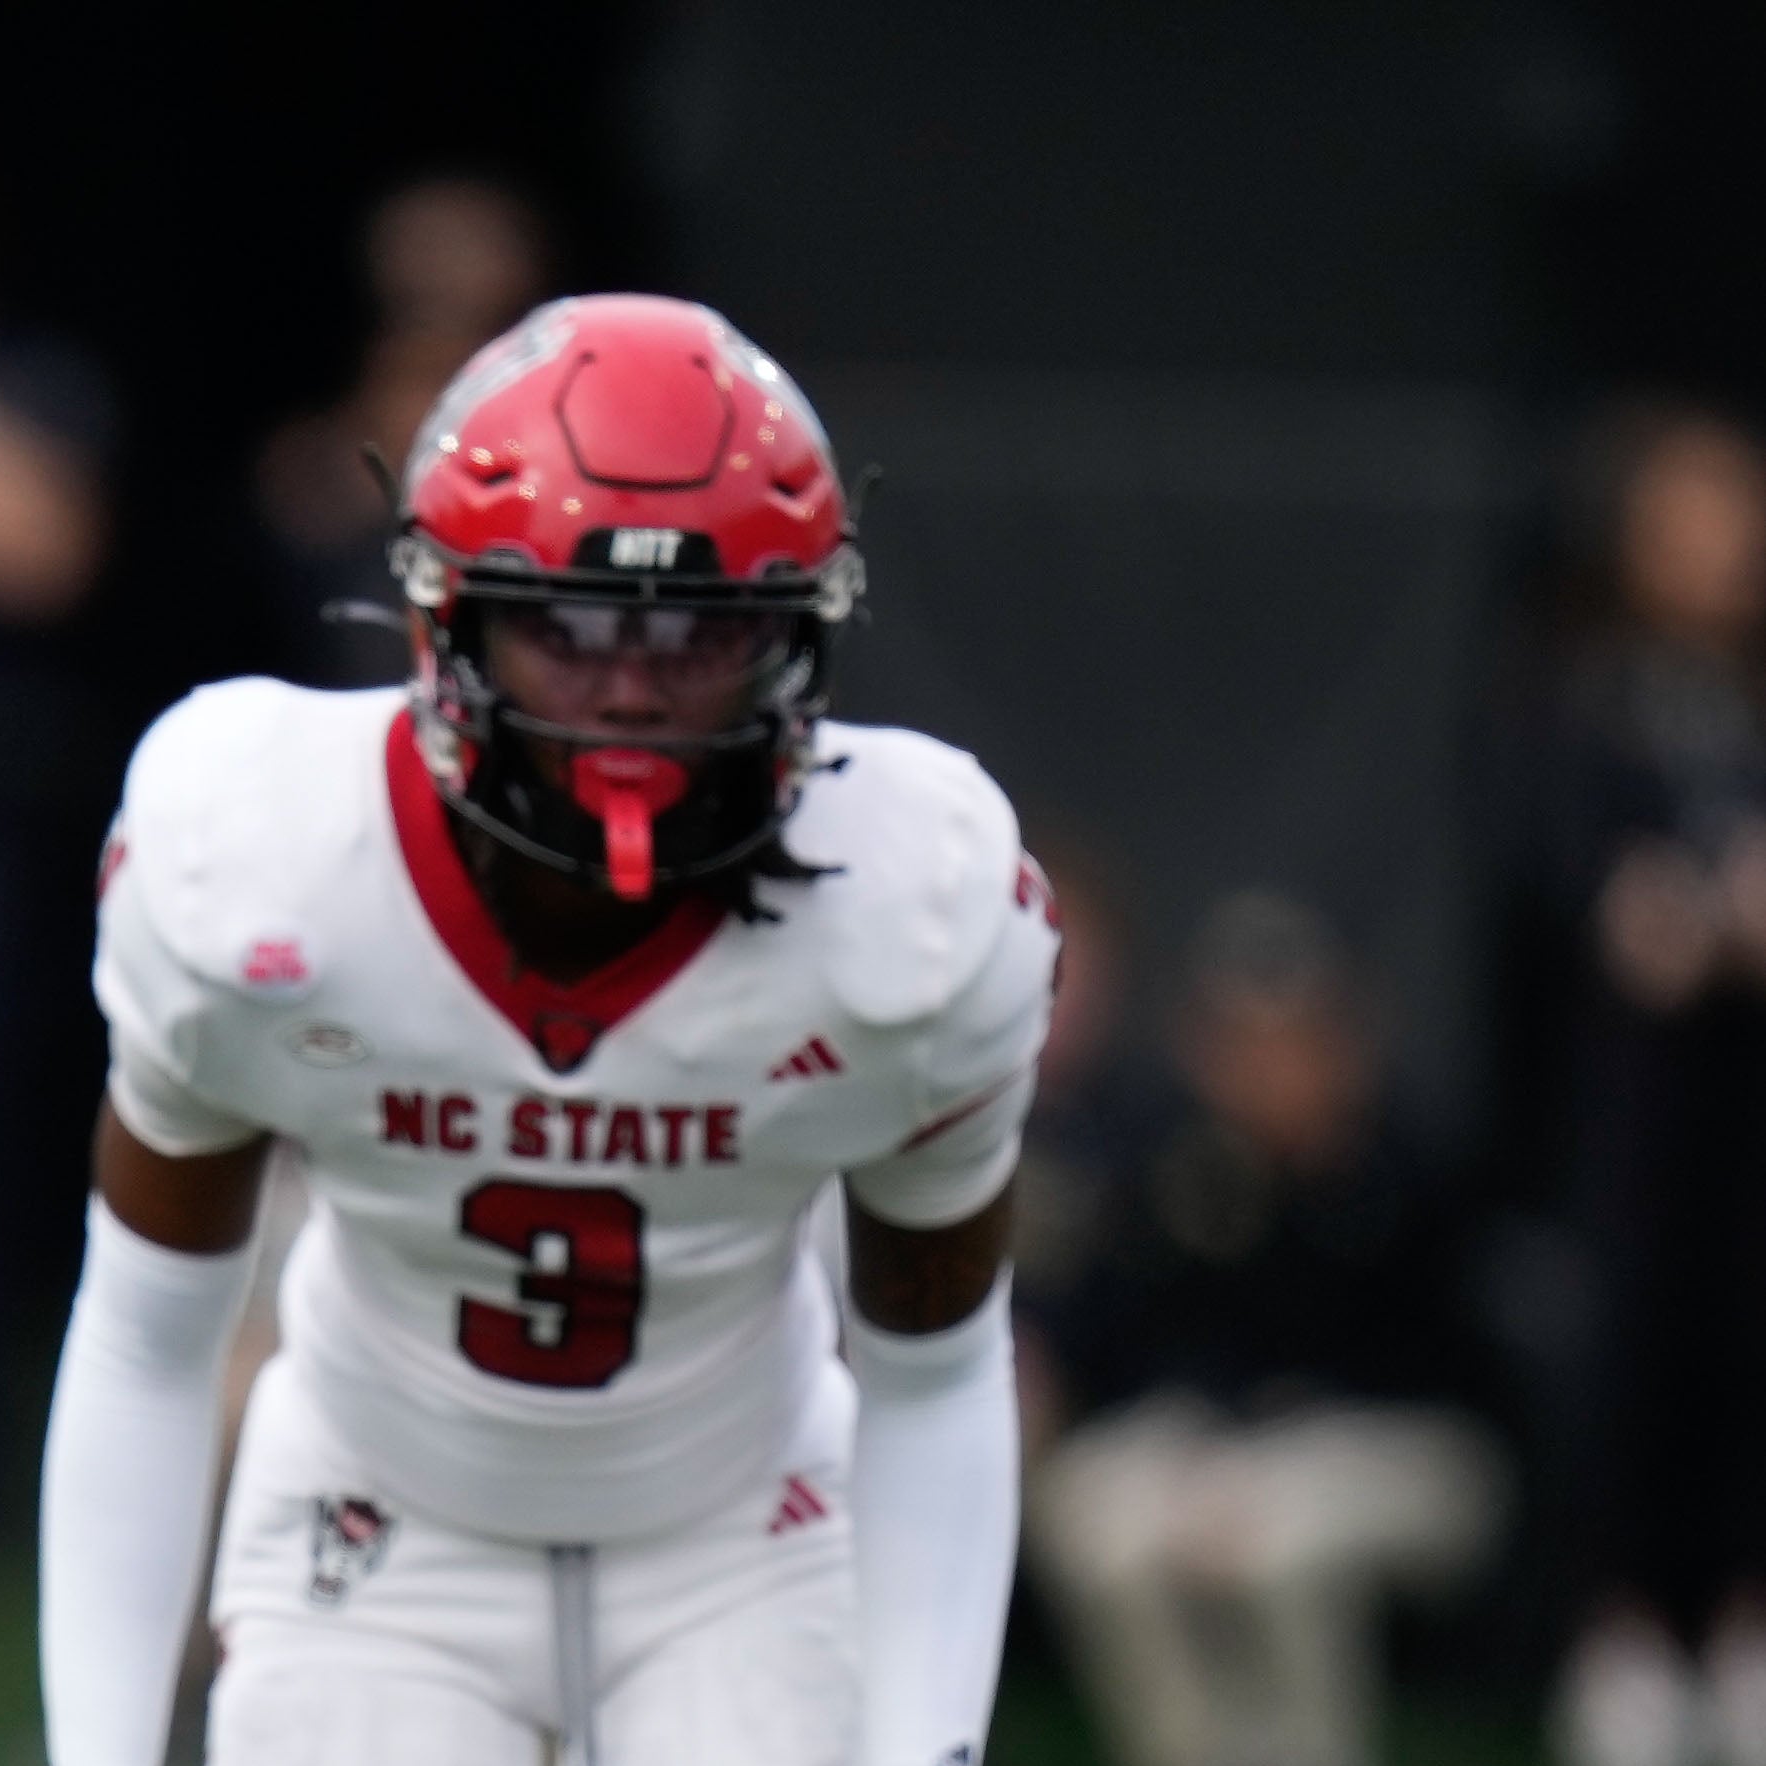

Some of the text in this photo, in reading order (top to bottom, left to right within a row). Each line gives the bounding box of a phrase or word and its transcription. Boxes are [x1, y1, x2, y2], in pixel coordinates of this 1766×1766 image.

[382, 1088, 741, 1168] NC STATE
[458, 1176, 647, 1390] 3
